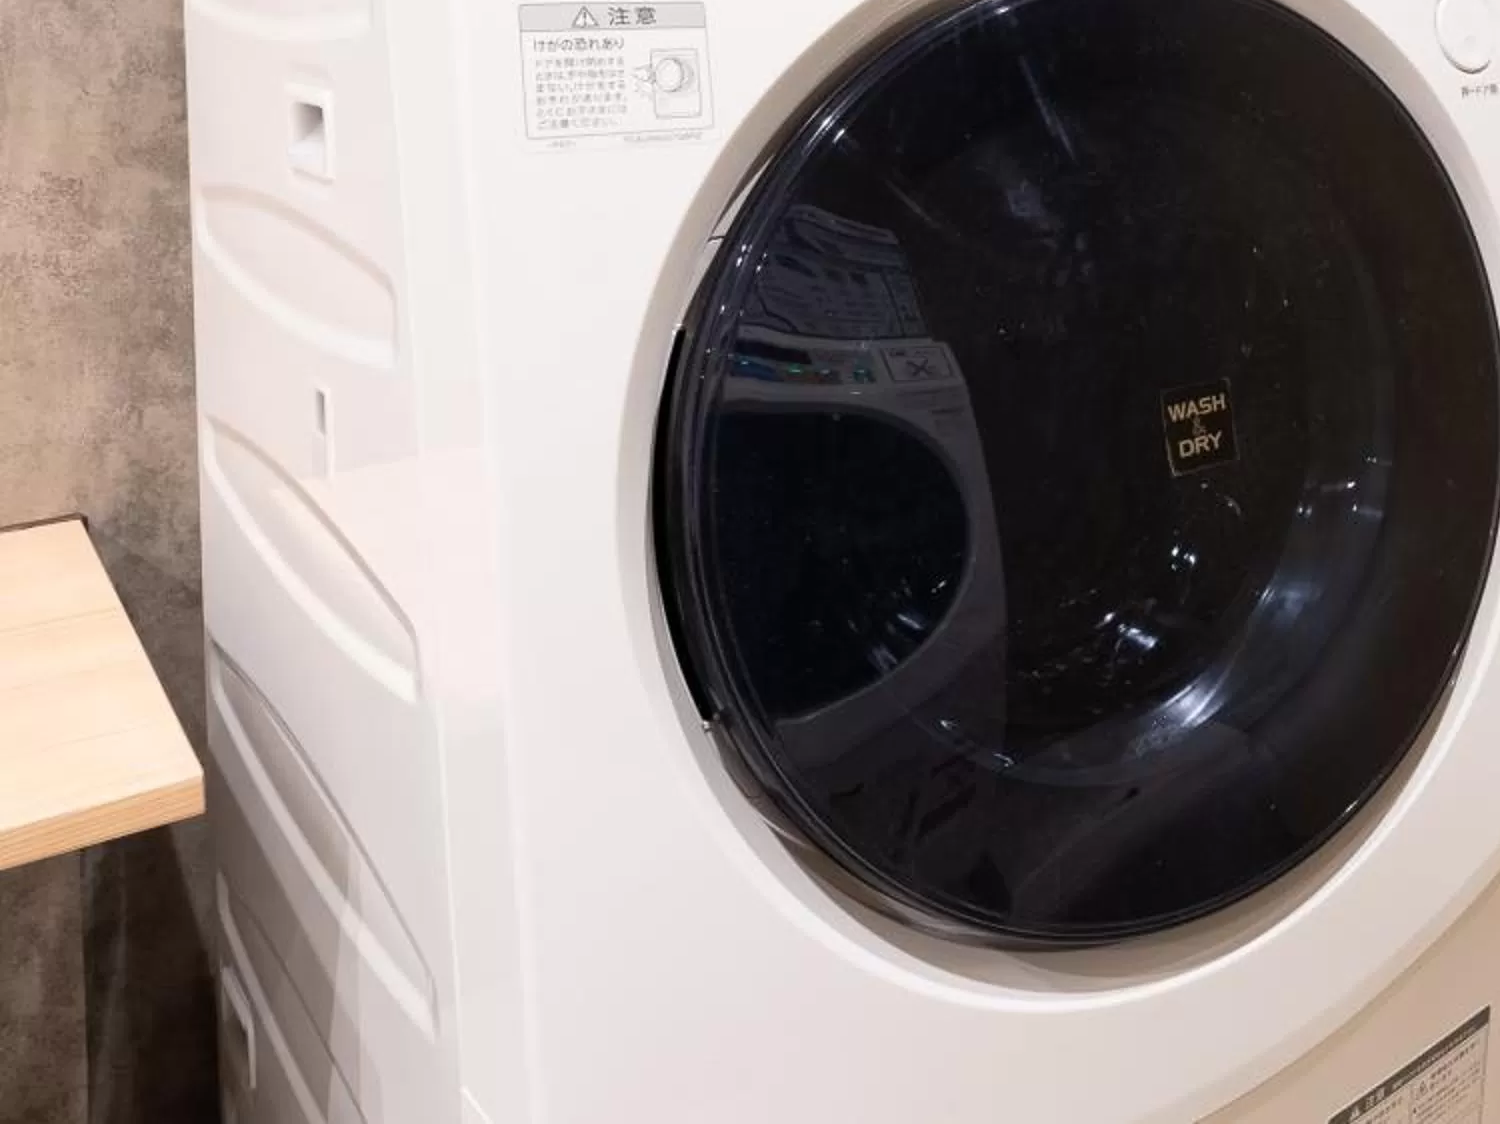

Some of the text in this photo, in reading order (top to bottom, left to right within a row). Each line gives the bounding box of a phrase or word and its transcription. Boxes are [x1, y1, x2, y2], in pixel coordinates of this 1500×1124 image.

[608, 6, 656, 25] 注意
[534, 37, 624, 52] けがの恐れあり
[1168, 393, 1226, 422] WASH
[1179, 431, 1222, 458] DRY
